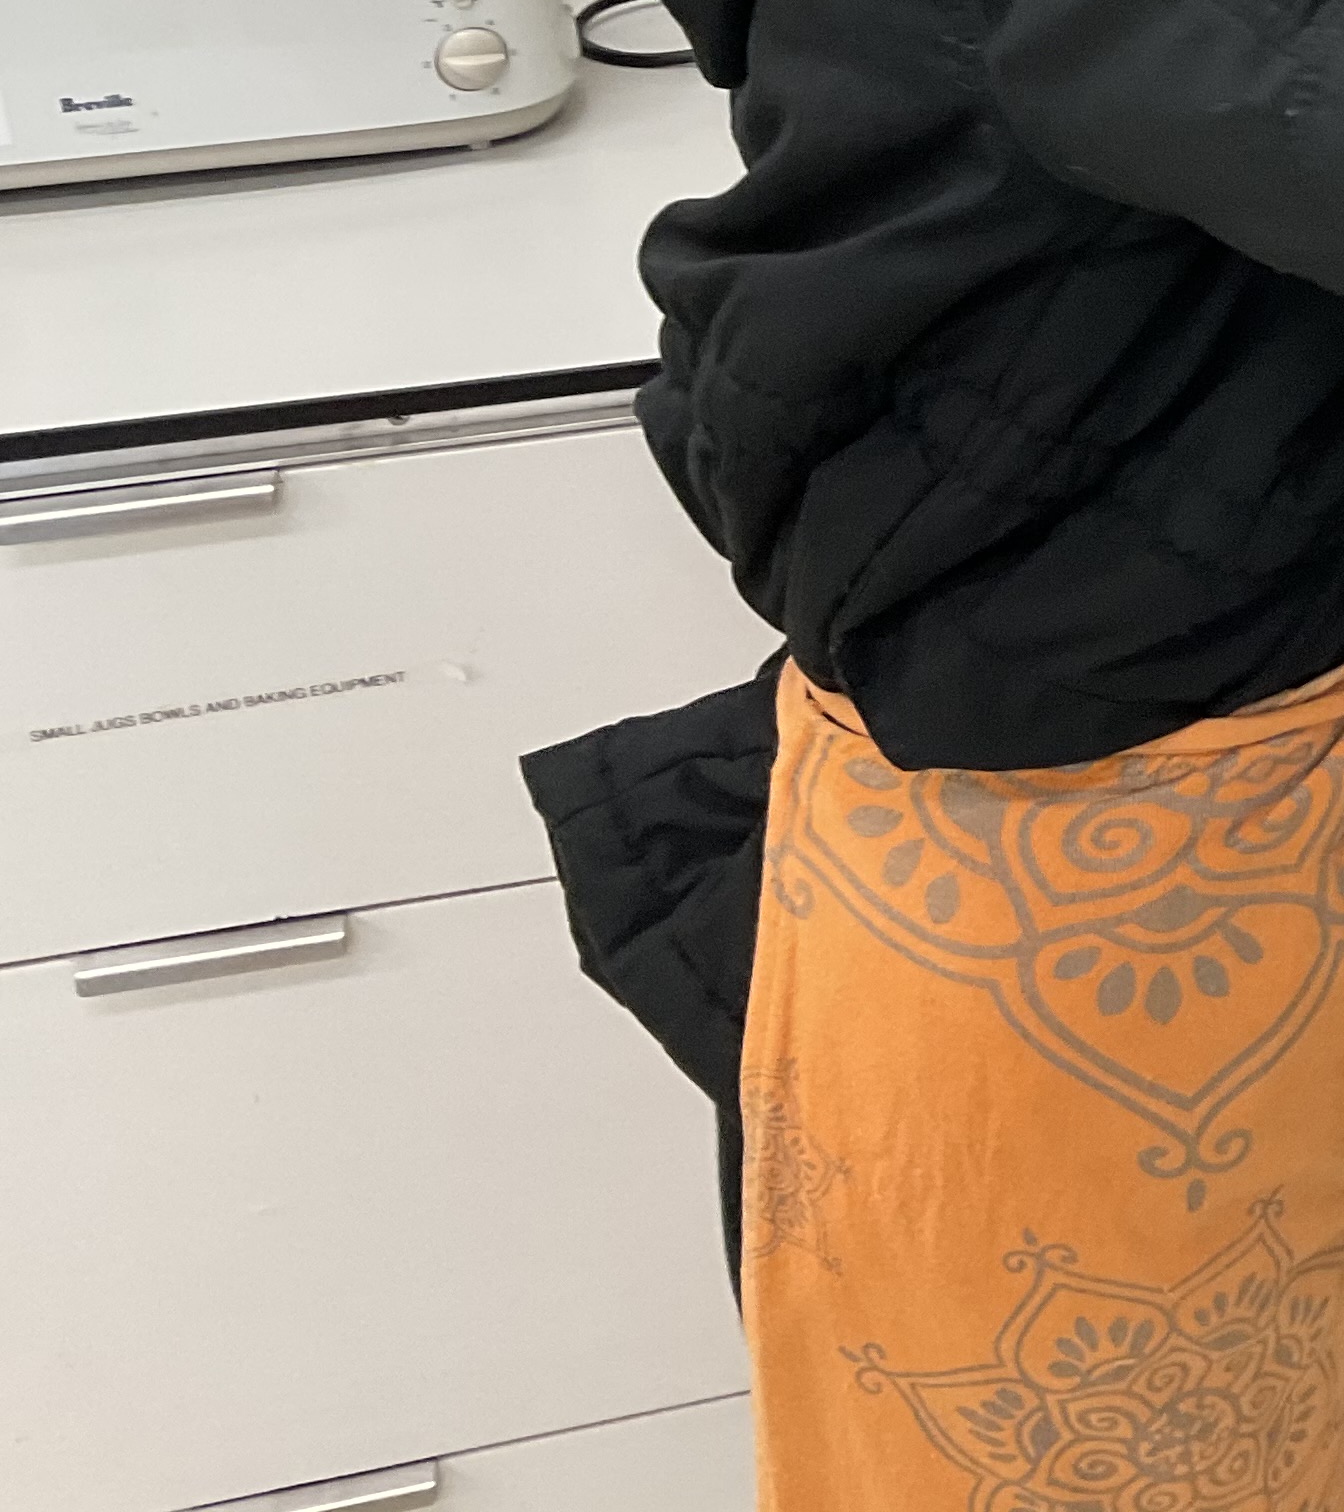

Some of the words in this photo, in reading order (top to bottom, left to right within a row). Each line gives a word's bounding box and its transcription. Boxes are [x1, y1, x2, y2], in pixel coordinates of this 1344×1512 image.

[30, 722, 86, 742] SMALL
[138, 703, 201, 725] BOWLS
[205, 697, 240, 713] AND
[243, 687, 307, 707] BAKING
[309, 670, 406, 696] EQUIPMENT
